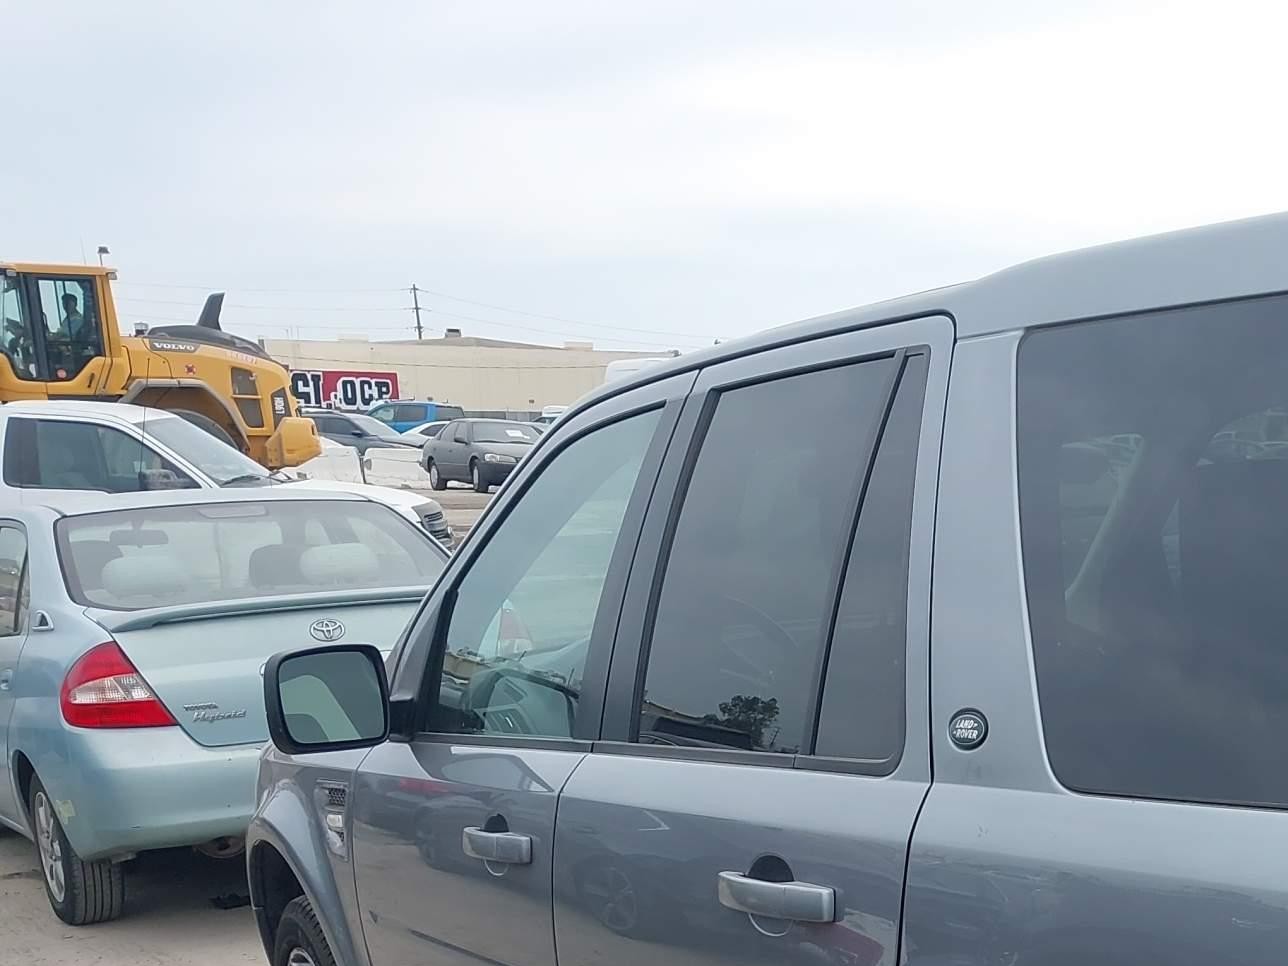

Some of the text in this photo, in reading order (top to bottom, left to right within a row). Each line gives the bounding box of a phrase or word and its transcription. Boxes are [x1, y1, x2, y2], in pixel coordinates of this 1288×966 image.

[153, 342, 195, 351] VOLVO
[955, 719, 975, 729] LAND
[955, 728, 978, 739] ROVER
